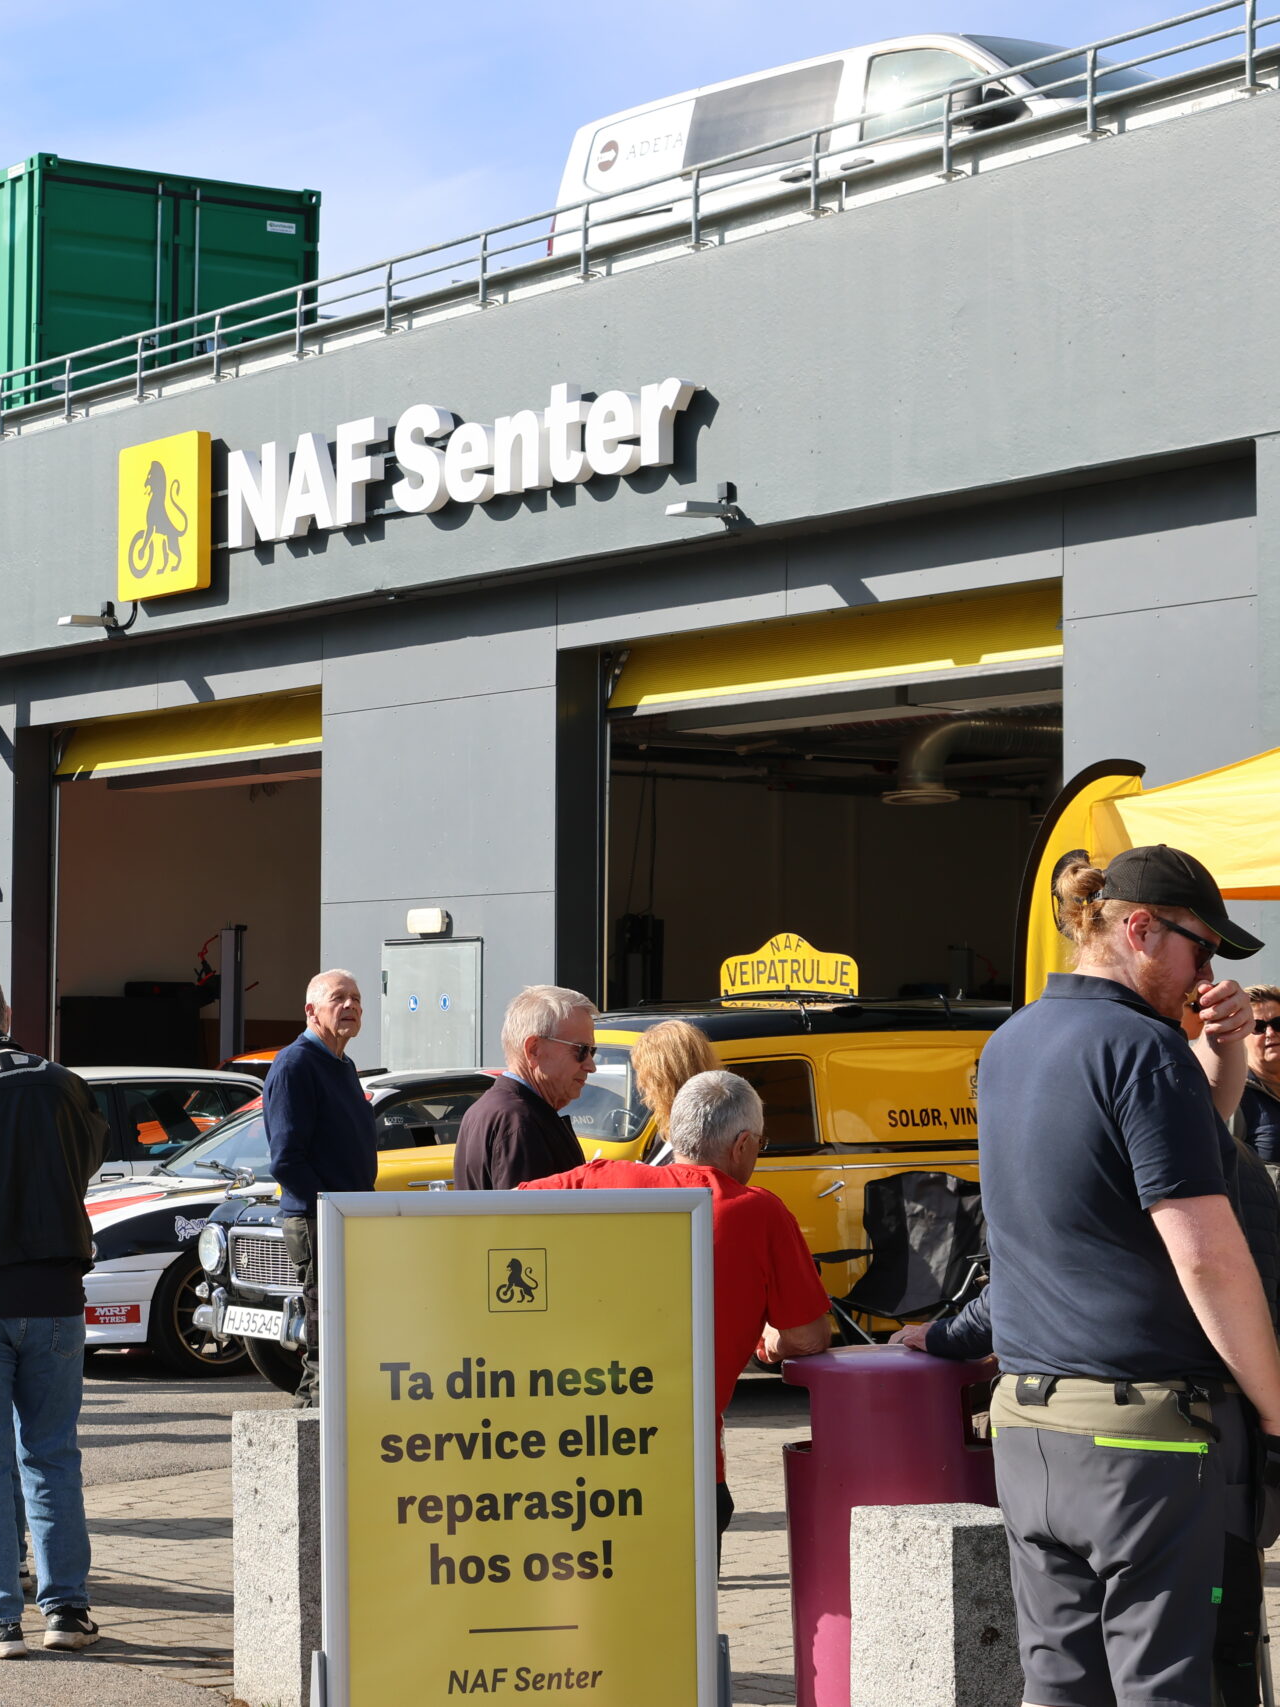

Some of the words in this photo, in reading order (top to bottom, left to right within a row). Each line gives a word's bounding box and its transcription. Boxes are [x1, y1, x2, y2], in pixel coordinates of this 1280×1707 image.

[625, 131, 684, 160] ADETA
[227, 415, 388, 549] NAF
[391, 377, 697, 514] Senter
[770, 934, 805, 956] NAF
[725, 958, 852, 987] VEIPATRULJE
[887, 1107, 948, 1131] SOLØR,
[94, 1306, 131, 1316] MRF
[99, 1315, 127, 1324] TYRES
[379, 1361, 434, 1401] Ta
[445, 1357, 516, 1400] din
[528, 1360, 654, 1397] neste
[380, 1418, 546, 1464] service
[558, 1414, 659, 1458] eller
[396, 1476, 644, 1536] reparasjon
[429, 1542, 511, 1585] hos
[522, 1539, 614, 1582] oss!
[447, 1667, 508, 1695] NAF
[513, 1666, 604, 1692] Senter
